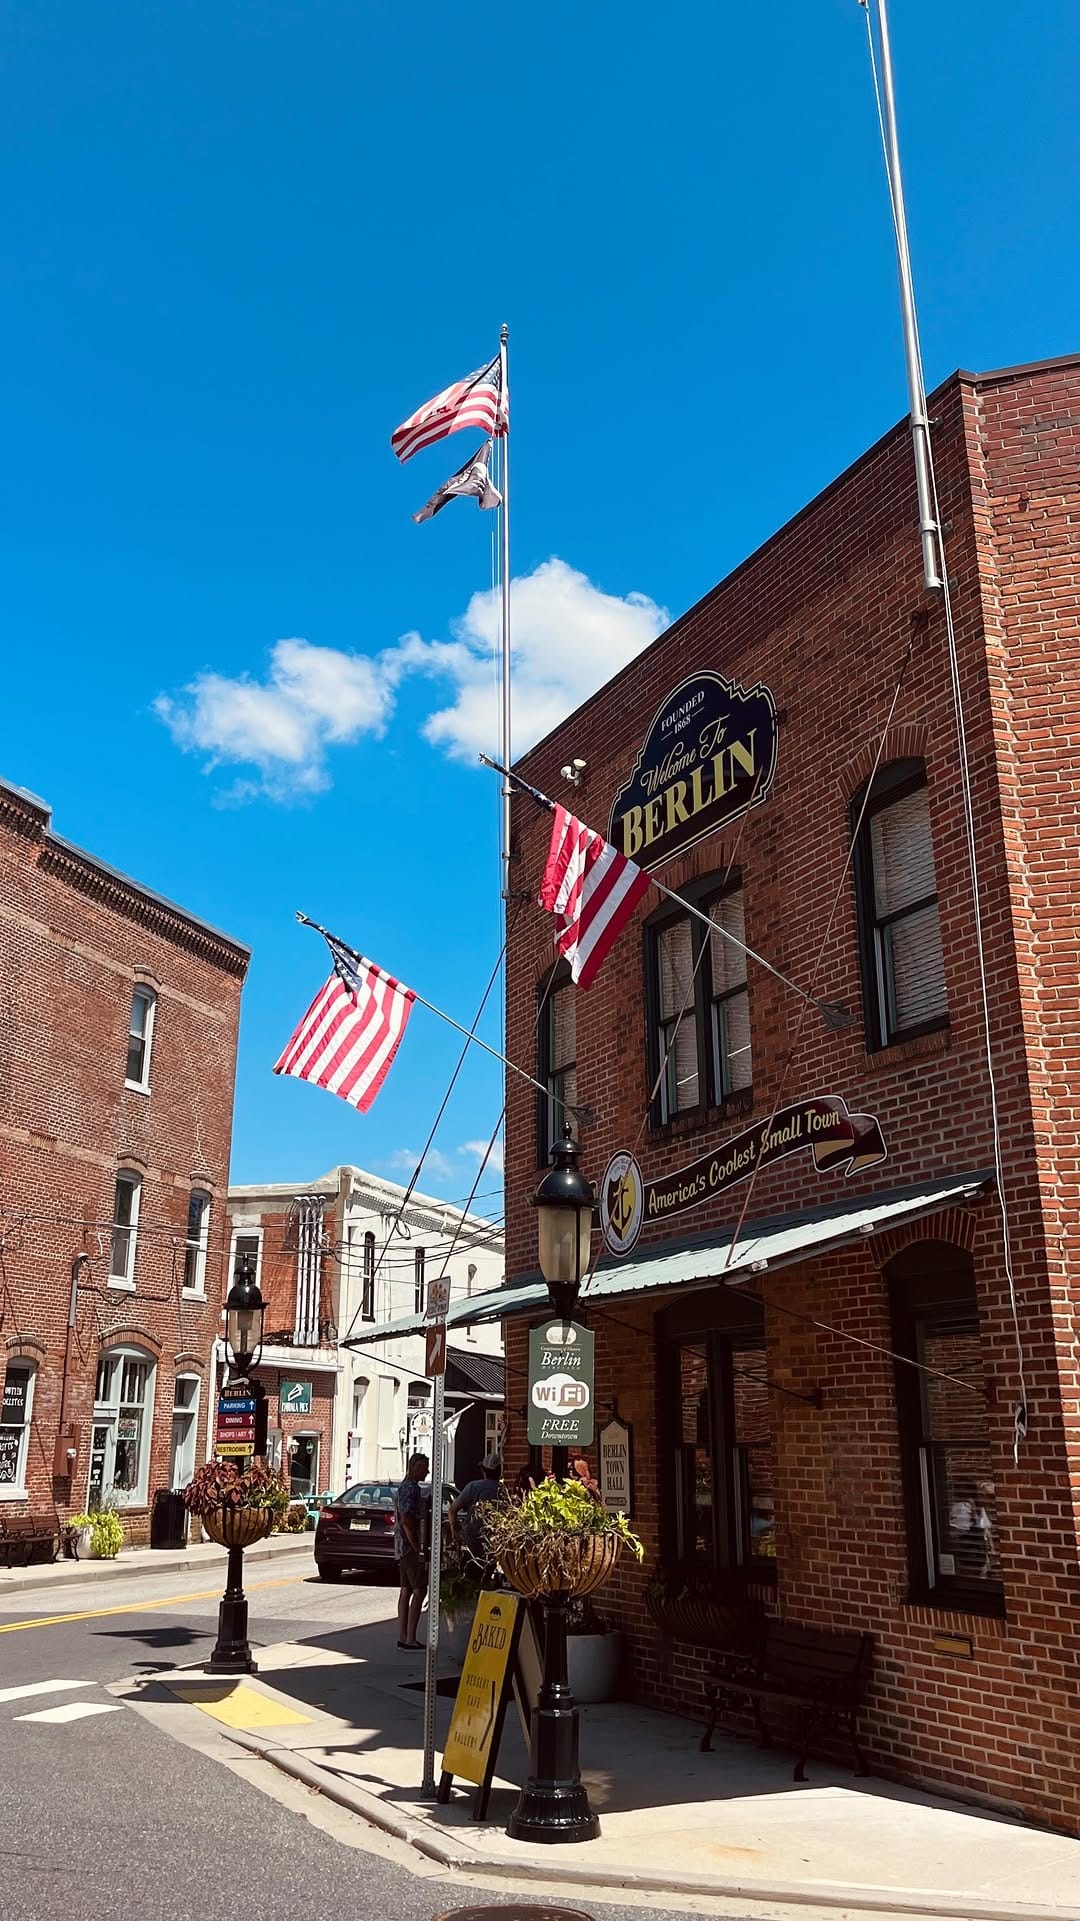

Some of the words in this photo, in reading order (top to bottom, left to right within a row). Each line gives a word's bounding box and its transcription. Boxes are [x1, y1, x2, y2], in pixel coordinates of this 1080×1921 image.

[661, 690, 705, 731] FOUNDED
[674, 714, 691, 734] 1868
[640, 741, 697, 796] Welcome
[699, 713, 731, 759] To
[621, 727, 758, 858] BERLIN
[648, 1174, 706, 1214] America's
[709, 1140, 756, 1187] Coolest
[760, 1114, 802, 1154] Small
[804, 1109, 841, 1133] Town
[540, 1351, 582, 1366] Berlin
[225, 1416, 243, 1424] DINING
[541, 1419, 580, 1431] FREE
[602, 1443, 627, 1458] BERLIN
[606, 1460, 625, 1475] TOWN
[607, 1476, 625, 1490] HALL
[472, 1623, 507, 1654] BAKED
[466, 1674, 489, 1689] DESSERT
